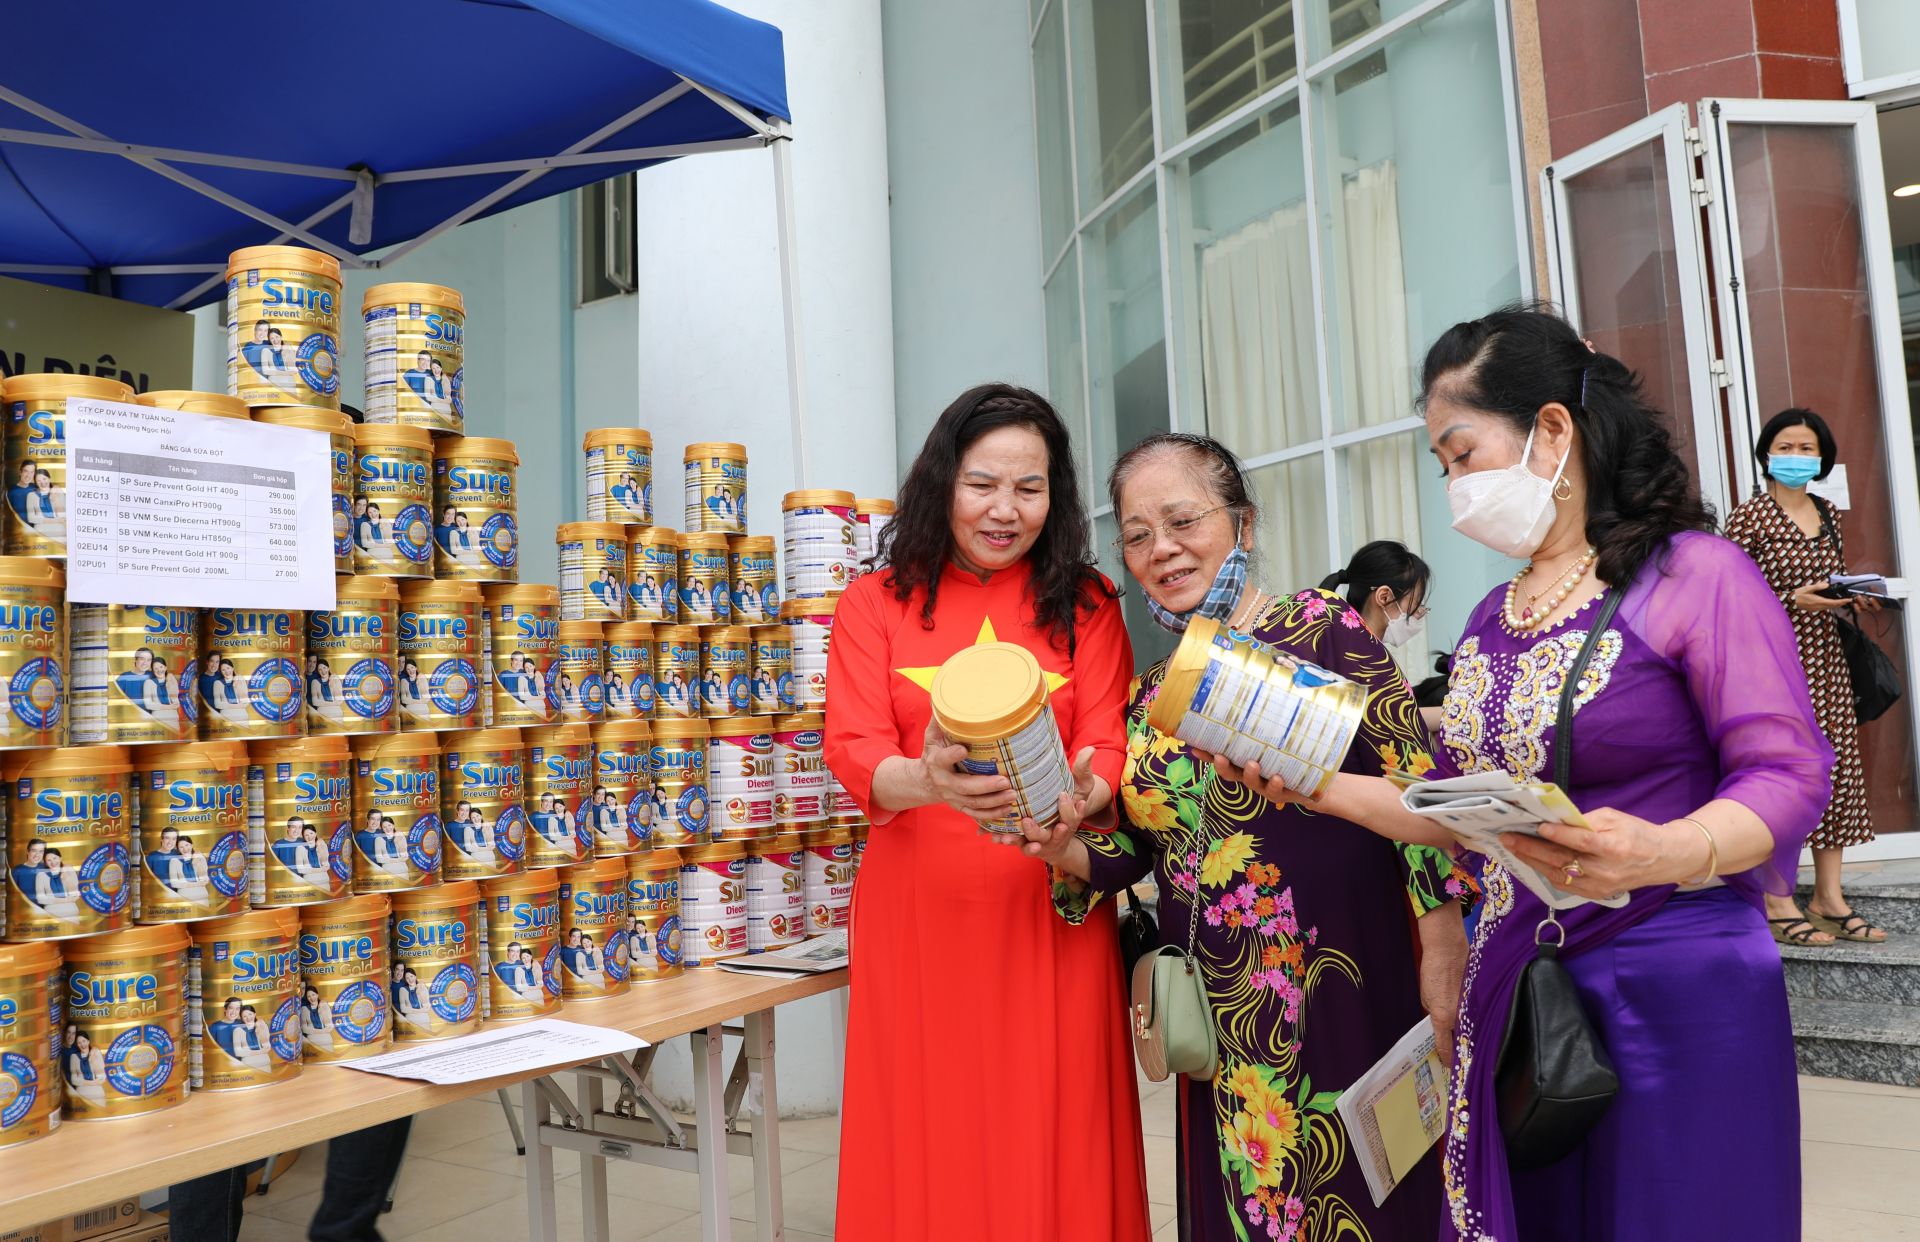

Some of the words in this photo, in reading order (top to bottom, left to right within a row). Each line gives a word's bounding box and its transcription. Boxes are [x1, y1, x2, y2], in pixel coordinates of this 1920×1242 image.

[262, 278, 333, 314] Sure
[262, 309, 300, 319] Prevent
[304, 313, 333, 326] Gold
[28, 411, 66, 444] Su
[28, 447, 66, 456] Preven
[360, 455, 426, 485] Sure
[77, 474, 110, 483] 02AU14
[120, 477, 131, 485] SP
[134, 479, 151, 488] Sure
[153, 481, 183, 491] Prevent
[186, 484, 204, 492] Gold
[207, 485, 218, 493] HT
[220, 488, 239, 496] 400g
[269, 491, 295, 500] 290.000
[449, 467, 510, 495] Sure
[360, 484, 395, 493] Prevent
[400, 485, 426, 499] Gold
[77, 491, 109, 500] 02EC13
[119, 494, 131, 502] SB
[133, 495, 151, 504] VNM
[153, 498, 190, 507] CanxiPro
[192, 501, 222, 511] HT900g
[269, 507, 295, 516] 355.000
[449, 495, 482, 503] Prevent
[486, 495, 510, 508] Gold
[77, 508, 107, 517] 02ED11
[133, 513, 150, 521] VNM
[153, 514, 171, 523] Sure
[174, 516, 209, 525] Diecerna
[211, 519, 241, 528] HT900g
[269, 523, 295, 531] 573.000
[77, 525, 107, 534] 02EK01
[153, 530, 178, 540] Kenko
[180, 533, 199, 541] Haru
[202, 534, 232, 544] HT850g
[77, 543, 108, 551] 02EU14
[132, 546, 150, 555] Sure
[153, 548, 183, 556] Prevent
[206, 550, 216, 558] HT
[220, 551, 238, 560] 900g
[270, 554, 296, 562] 603.000
[644, 548, 676, 565] Sure
[692, 553, 726, 569] Sure
[77, 560, 106, 568] 02PU01
[118, 562, 129, 570] SP
[131, 563, 149, 571] Sure
[151, 564, 180, 573] Prevent
[182, 566, 200, 574] Gold
[205, 567, 229, 575] 200ML
[275, 570, 297, 578] 27.000
[741, 557, 774, 571] Sure
[0, 604, 56, 632] ure
[144, 606, 198, 635] Sur
[213, 608, 290, 637] Sure
[311, 610, 383, 639] Sure
[400, 612, 467, 640] Sure
[21, 634, 56, 649] Gold
[145, 636, 182, 645] Prevent
[213, 638, 252, 647] Prevent
[255, 637, 291, 651] Gold
[311, 639, 346, 648] Prevent
[350, 639, 383, 652] Gold
[400, 640, 432, 649] Prevent
[436, 640, 467, 652] Gold
[517, 640, 546, 648] Prevent
[560, 645, 598, 661] Sure
[610, 645, 648, 662] Sure
[710, 646, 746, 662] Sure
[759, 645, 791, 660] Sure
[599, 751, 650, 775] Sure
[650, 746, 704, 770] Sure
[373, 767, 436, 796] Sure
[462, 761, 520, 788] Sure
[599, 775, 629, 784] Prevent
[651, 771, 678, 779] Prevent
[681, 770, 703, 781] Gold
[463, 789, 496, 798] Prevent
[547, 782, 577, 790] Prevent
[169, 780, 243, 812] Sure
[374, 796, 410, 806] Prevent
[413, 794, 436, 808] Gold
[36, 788, 122, 823] Sure
[296, 803, 331, 813] Prevent
[334, 801, 350, 815] Gol
[169, 812, 212, 823] Prevent
[216, 810, 244, 826] Gold
[37, 823, 84, 835] Prevent
[88, 819, 122, 836] Gold
[782, 871, 800, 893] Su
[628, 879, 678, 903] Sure
[574, 891, 625, 917] Sure
[629, 903, 658, 911] Prevent
[575, 917, 605, 925] Prevent
[397, 919, 465, 948] Sure
[514, 929, 544, 939] Prevent
[300, 934, 373, 966] Sure
[398, 948, 432, 958] Prevent
[435, 945, 466, 959] Gold
[232, 950, 300, 982] Sure
[300, 965, 335, 975] Prevent
[339, 960, 373, 977] Gold
[69, 971, 157, 1007] Sure
[233, 982, 273, 993] Prevent
[69, 1007, 110, 1017] Prevent
[114, 1000, 157, 1020] Gold
